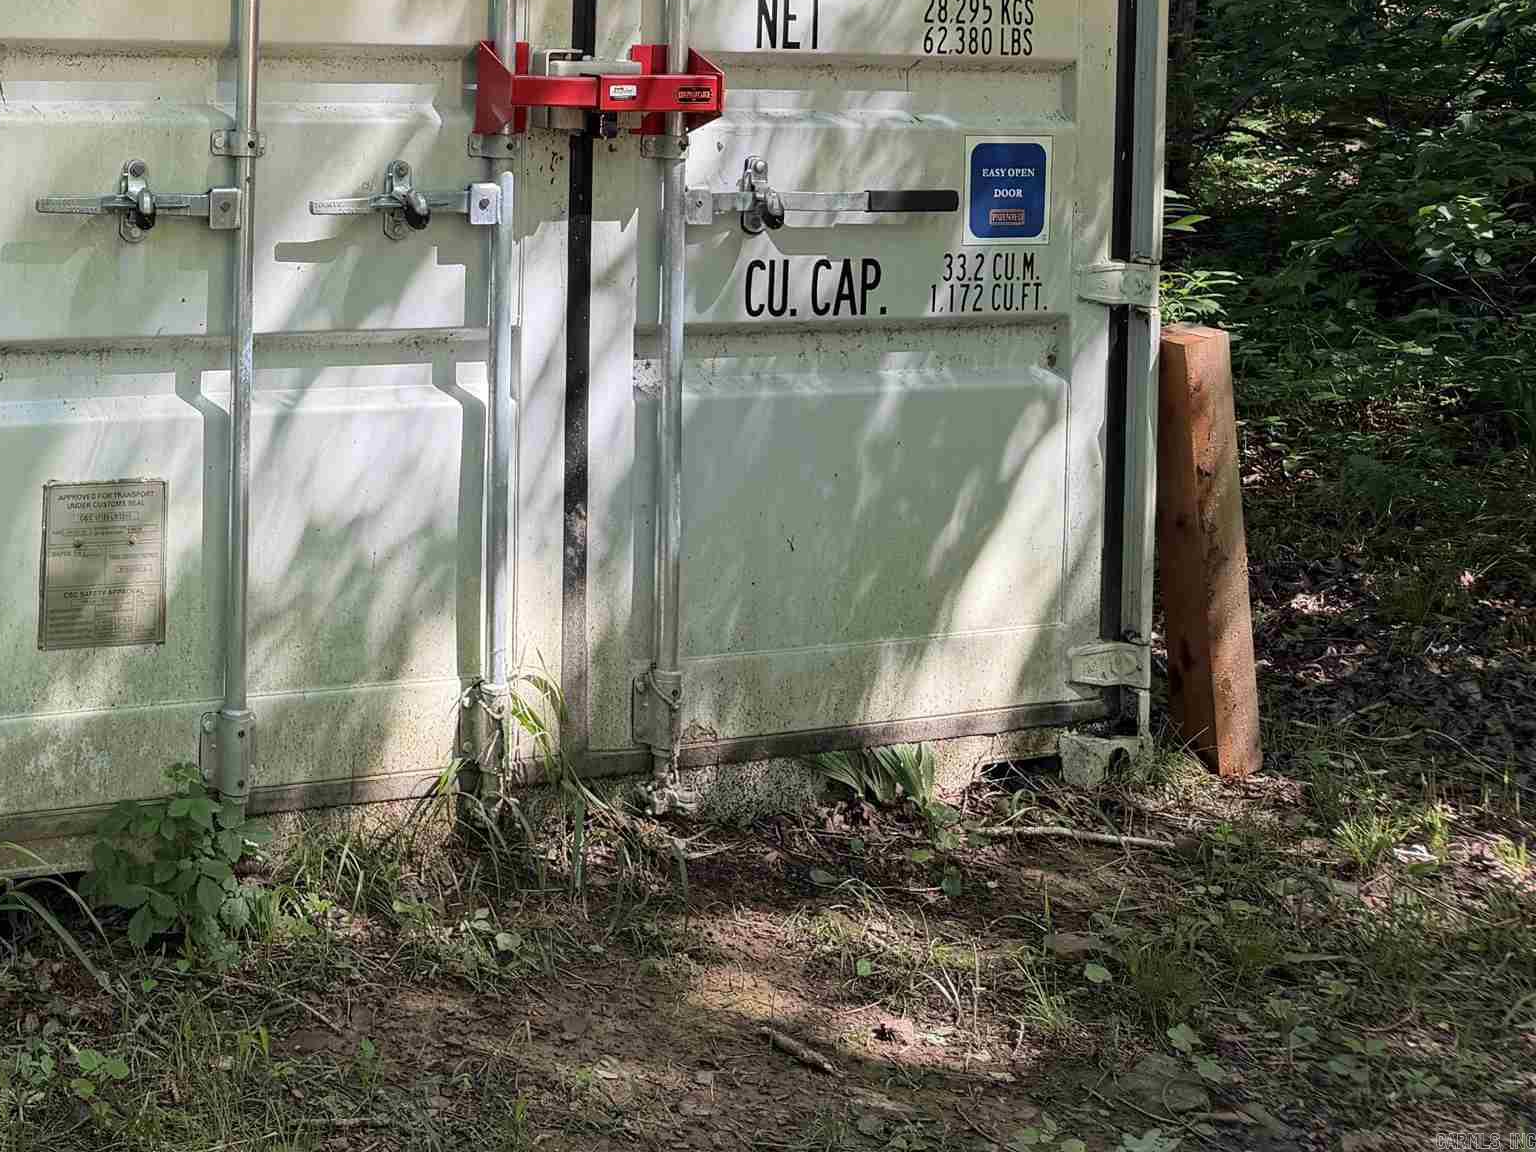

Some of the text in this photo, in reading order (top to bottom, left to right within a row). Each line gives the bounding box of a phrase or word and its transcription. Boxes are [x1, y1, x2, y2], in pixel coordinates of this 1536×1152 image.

[923, 26, 1033, 57] 62,380 LBS
[982, 168, 1035, 177] EASY OPEN
[993, 188, 1023, 198] DOOR
[943, 253, 1041, 281] 33.2 CU.M.
[745, 258, 888, 317] CU. CAP.
[930, 282, 1048, 313] 1,172 CU.FT.
